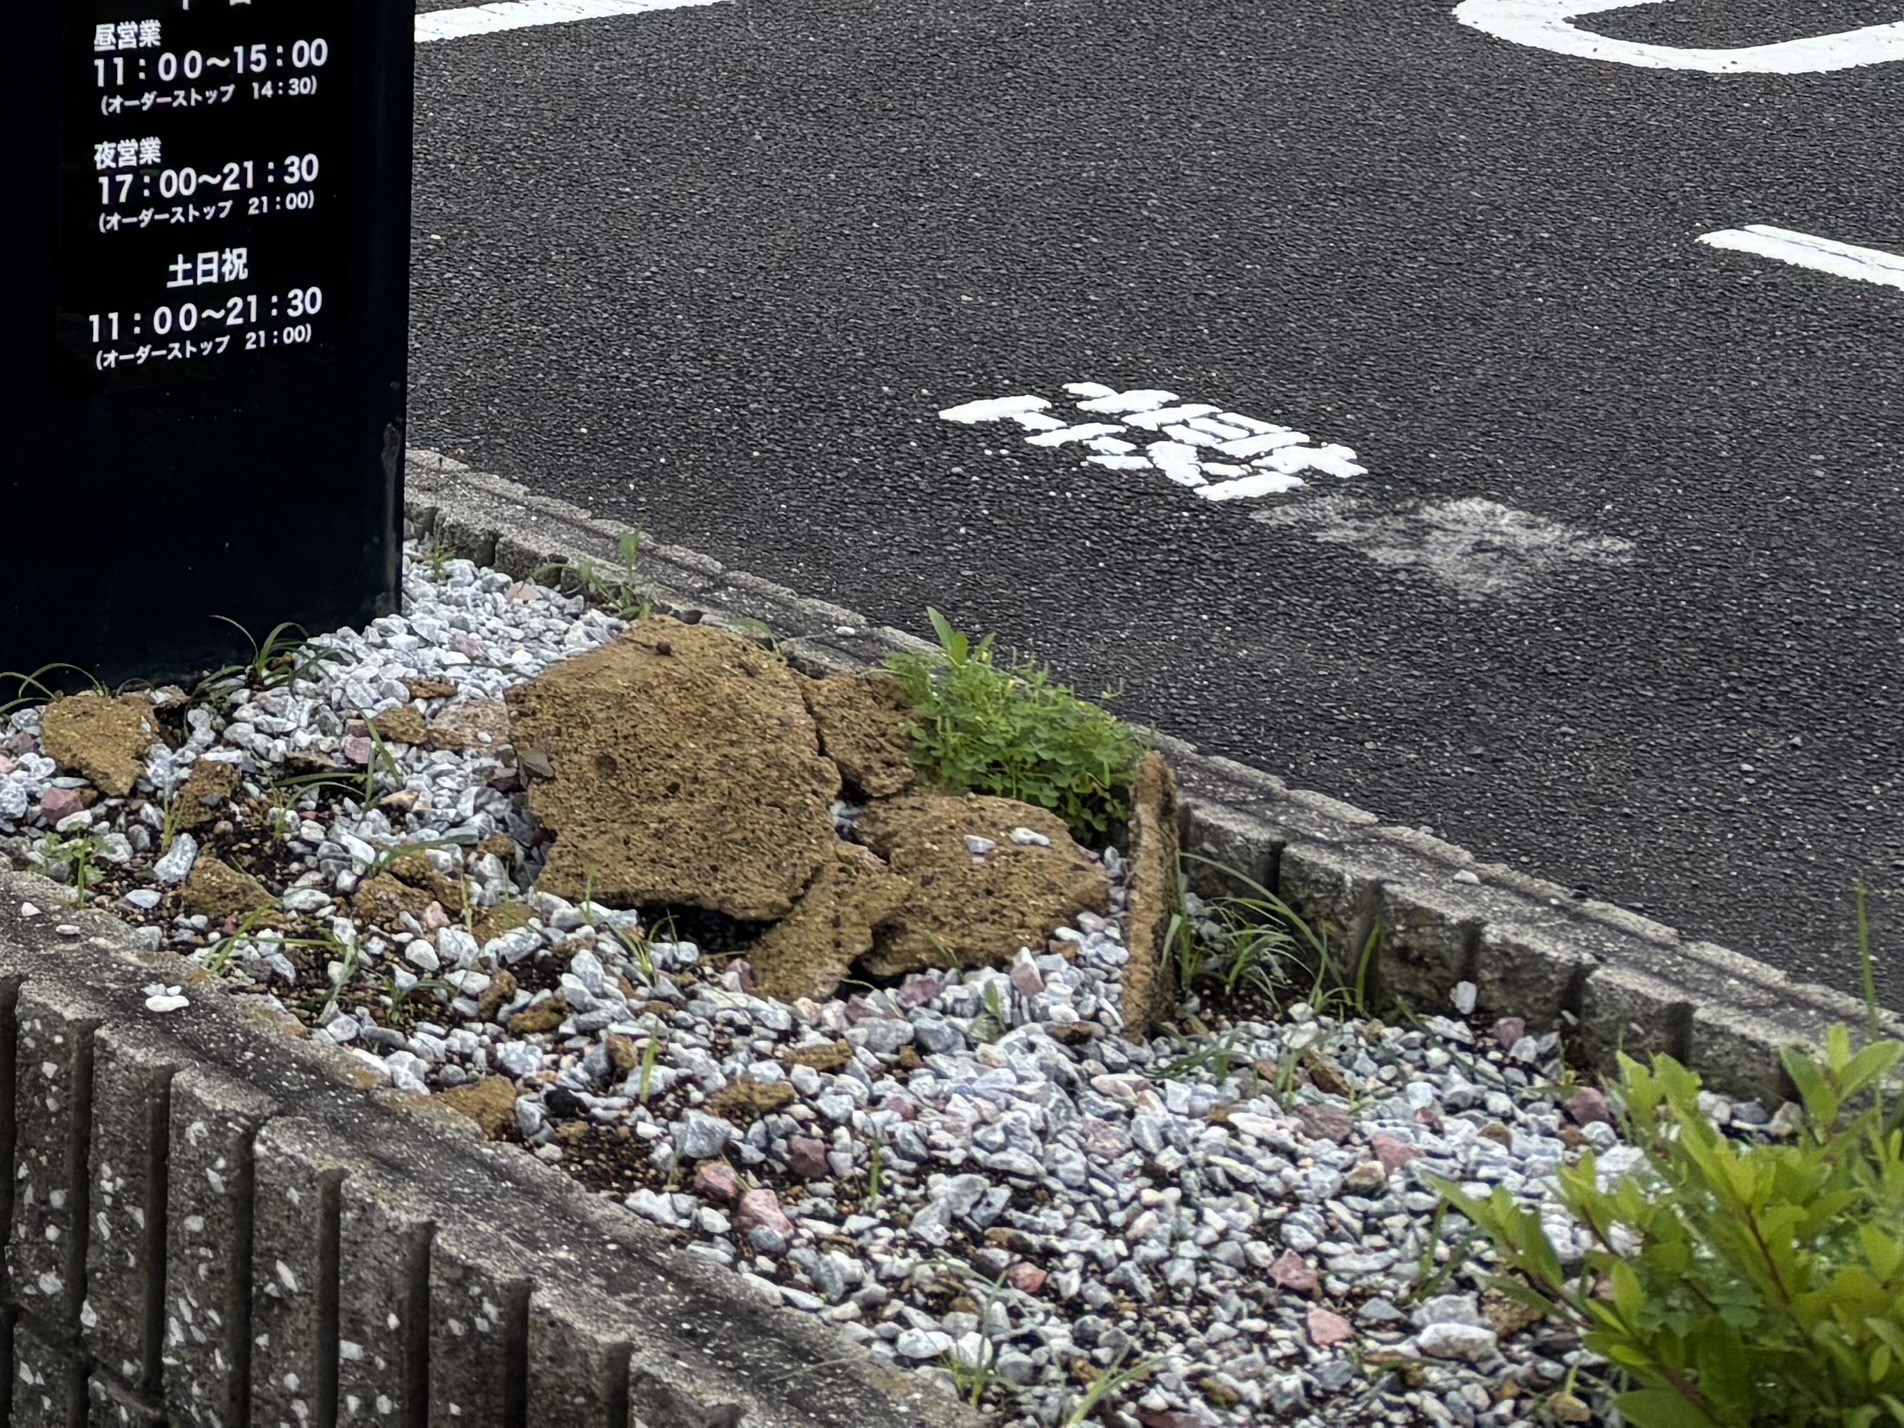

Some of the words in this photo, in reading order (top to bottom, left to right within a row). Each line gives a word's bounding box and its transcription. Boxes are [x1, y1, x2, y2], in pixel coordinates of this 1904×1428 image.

[93, 19, 162, 52] 昼営業
[93, 136, 162, 170] 夜営業
[166, 247, 249, 288] 土日祝
